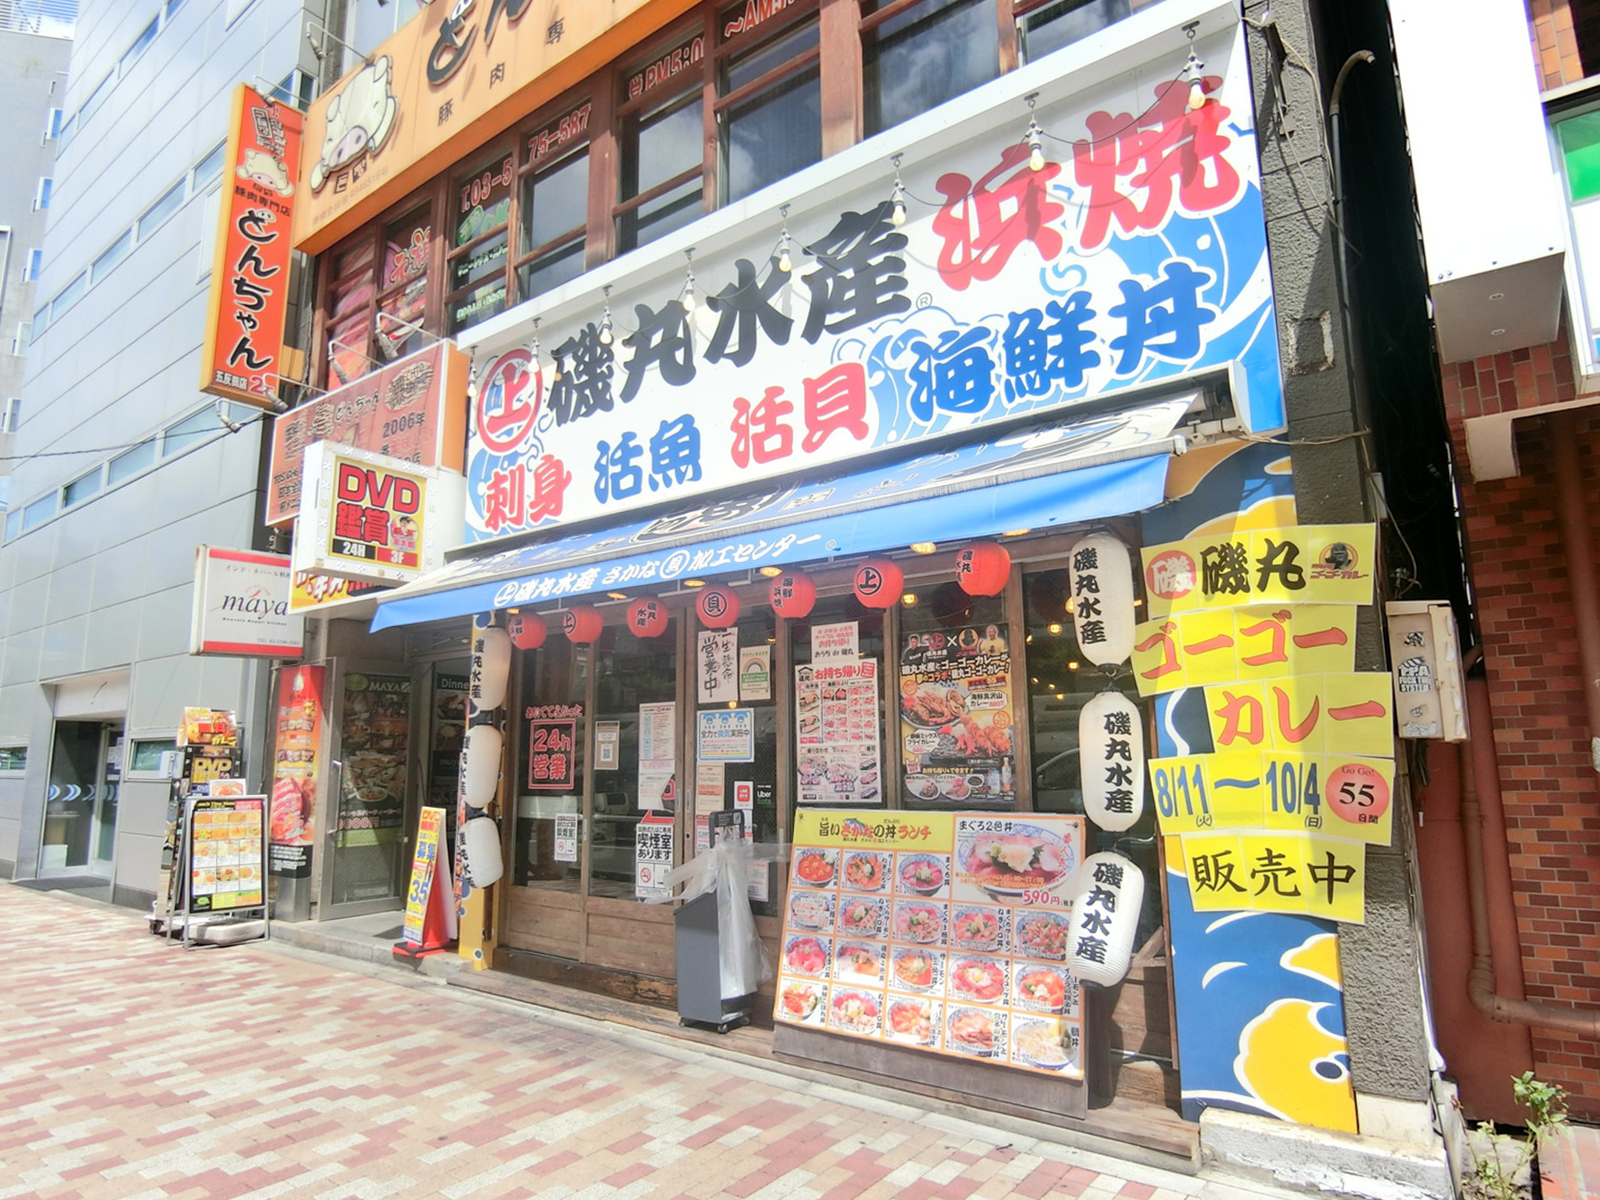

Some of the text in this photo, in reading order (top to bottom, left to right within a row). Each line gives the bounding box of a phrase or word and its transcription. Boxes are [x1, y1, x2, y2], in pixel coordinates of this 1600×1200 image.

[932, 76, 1240, 291] 浜焼
[226, 209, 281, 369] どんちゃん
[548, 200, 912, 427] 磯丸水産
[485, 261, 1216, 531] 刺身 活魚 活貝 海鮮丼
[383, 411, 425, 438] 2006年
[338, 463, 420, 515] DVD
[336, 501, 390, 546] 鑑賞
[342, 542, 366, 557] 24H
[390, 550, 405, 564] 3F
[1200, 538, 1306, 597] 磯丸
[222, 594, 289, 620] maya
[1073, 547, 1107, 645] 磯丸水産
[701, 636, 719, 698] 営業中
[1134, 609, 1347, 680] ゴーゴー
[815, 665, 861, 680] お持ち帰り
[534, 728, 571, 751] 24h
[1214, 686, 1386, 745] カレー
[533, 754, 567, 780] 営業
[1104, 711, 1133, 814] 磯丸水産
[1341, 766, 1375, 776] Go Go!
[1154, 763, 1209, 818] 8/11
[1266, 761, 1321, 815] 10/4
[1338, 782, 1375, 807] 55
[638, 833, 672, 849] 喫煙室
[959, 820, 1013, 832] まぐろ2色丼
[1358, 813, 1379, 824] 日間
[638, 849, 672, 860] あります
[1191, 848, 1357, 905] 販売中
[1075, 862, 1124, 964] 磯丸水産
